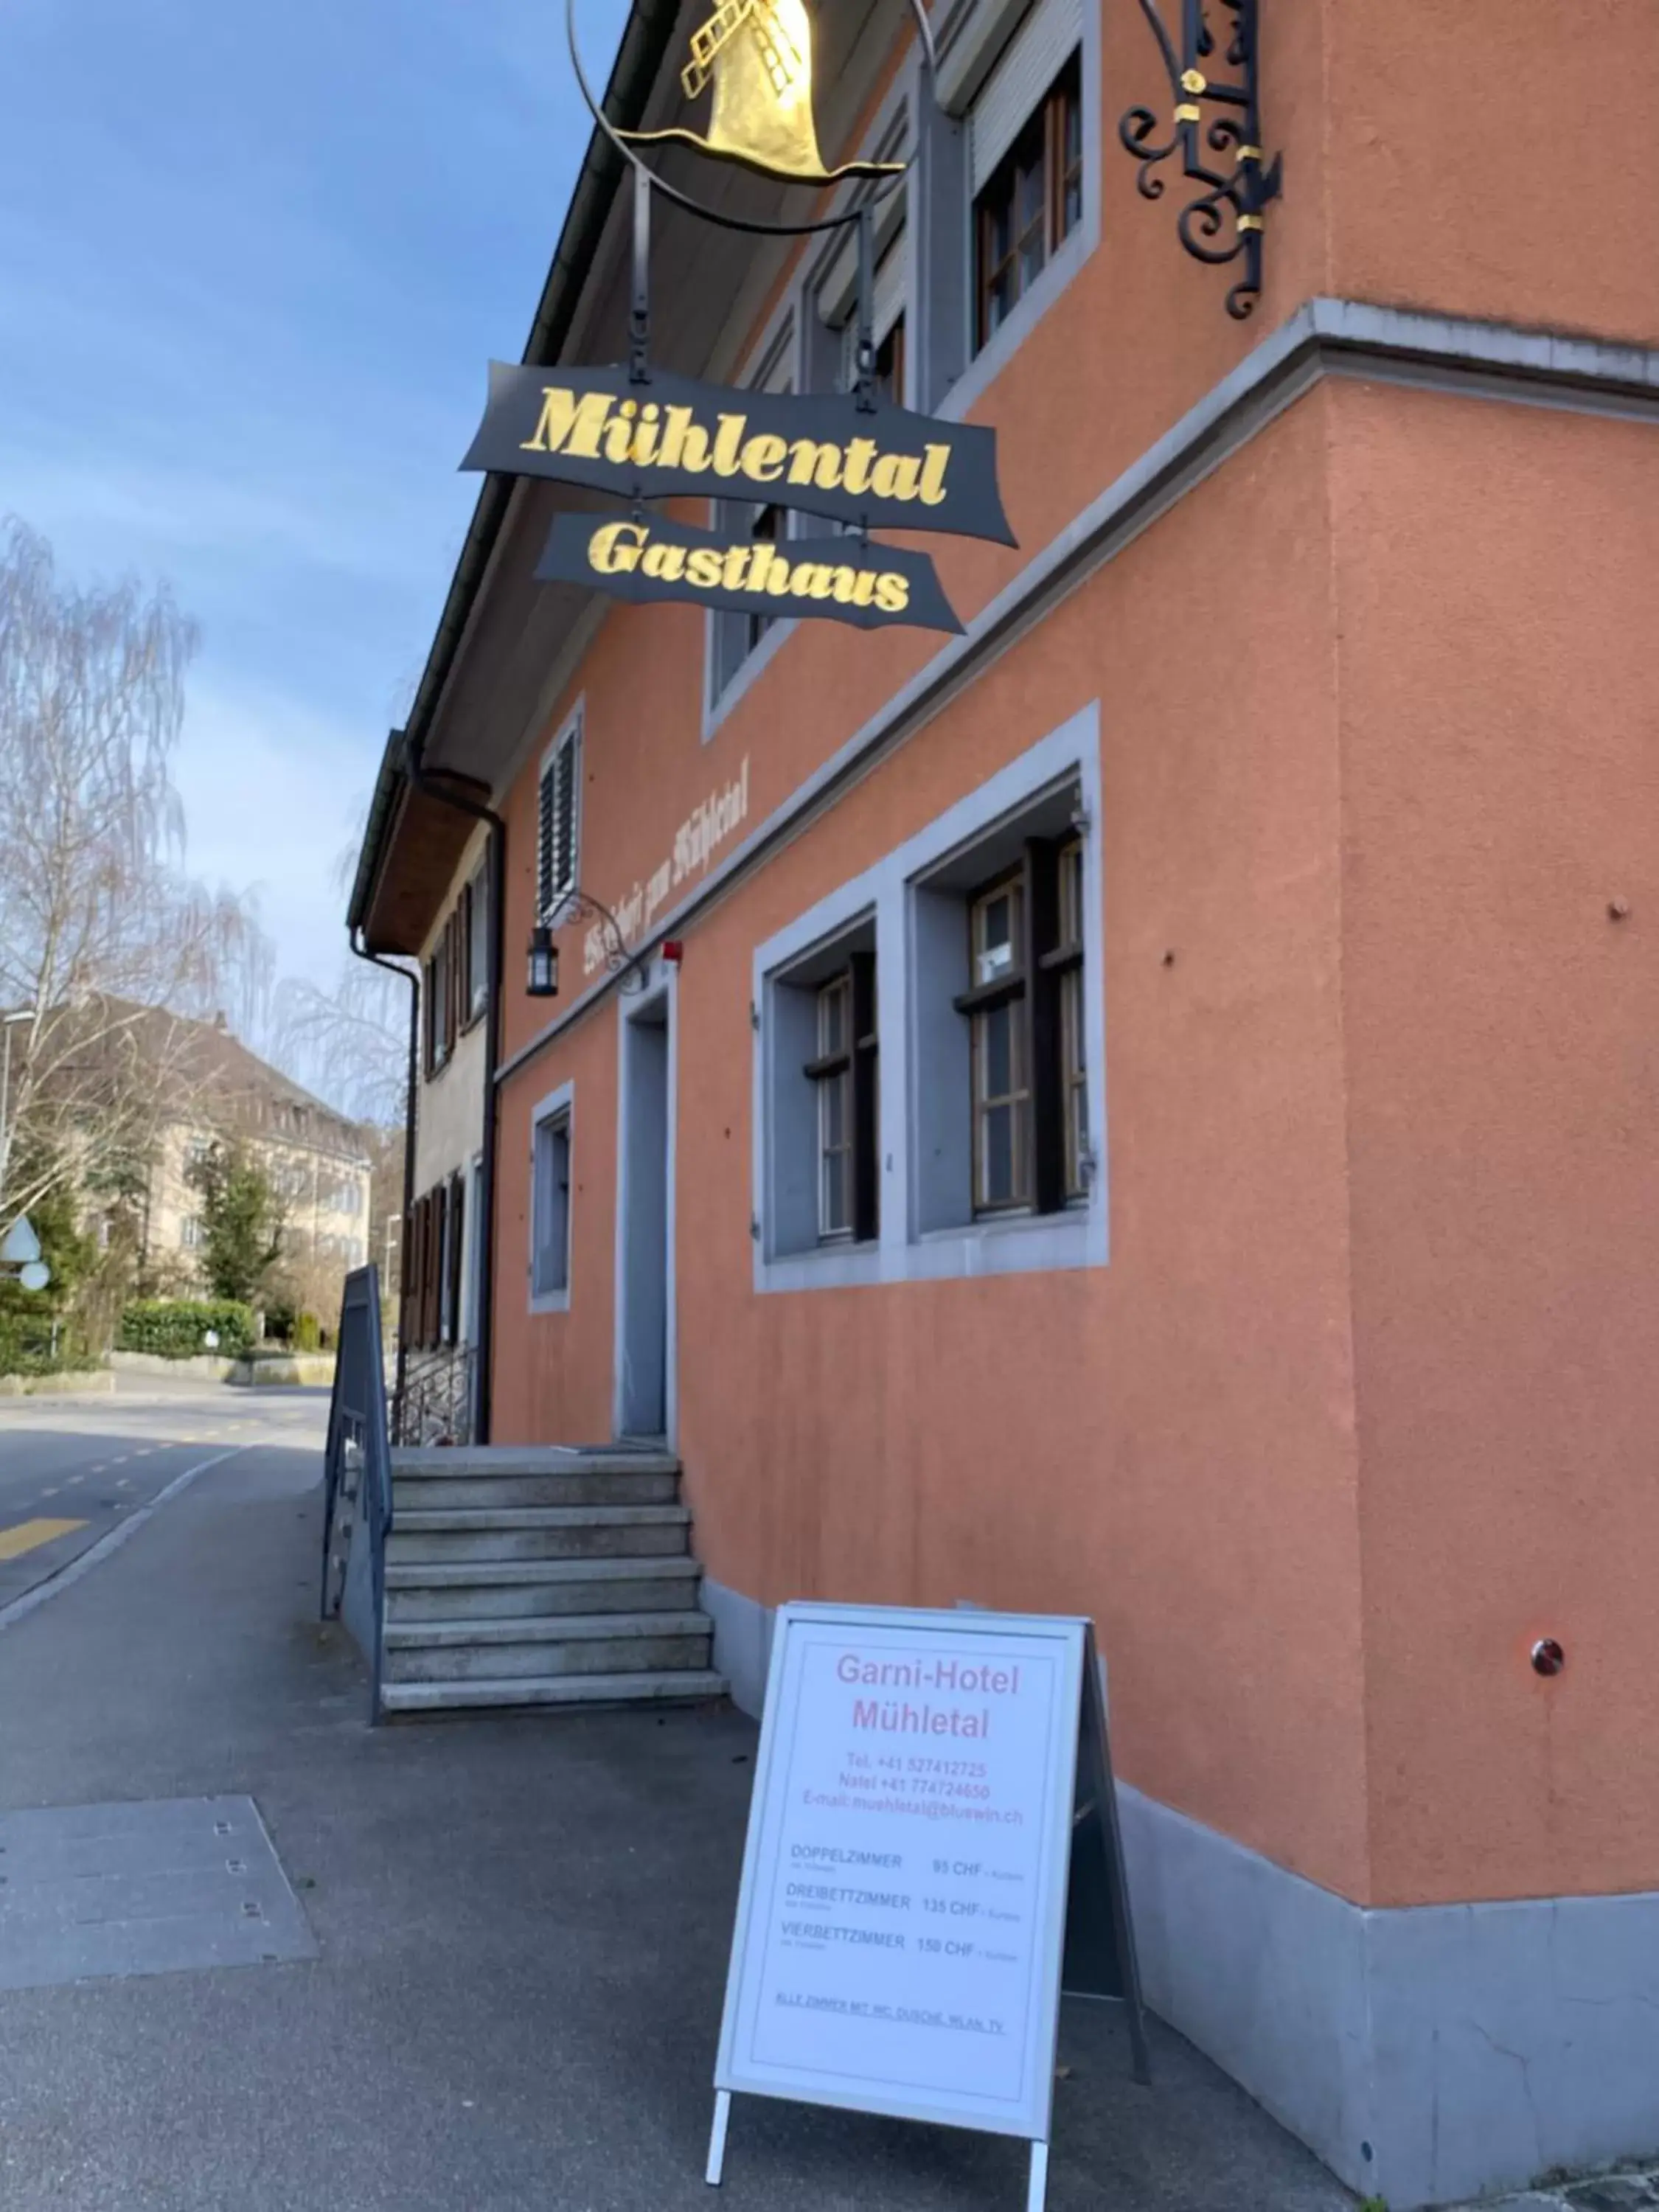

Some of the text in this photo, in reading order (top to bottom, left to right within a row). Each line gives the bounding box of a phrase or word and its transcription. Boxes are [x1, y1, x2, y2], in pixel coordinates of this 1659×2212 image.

[519, 386, 952, 505] Mühlental
[588, 521, 910, 613] Gasthaus
[837, 1653, 1020, 1695] Garni-Hotel
[852, 1699, 990, 1739] Mühletal
[846, 1752, 871, 1768] Tel.
[878, 1756, 902, 1771] +41
[839, 1771, 877, 1790] Natel
[881, 1776, 905, 1792] +41
[790, 1843, 902, 1868] DOPPELZIMMER
[953, 1860, 981, 1877] CHF
[786, 1882, 911, 1910] DREIBETTZIMMER
[950, 1899, 981, 1916] CHF
[781, 1921, 905, 1950] VIERBETTZIMMER
[945, 1940, 975, 1958] CHF
